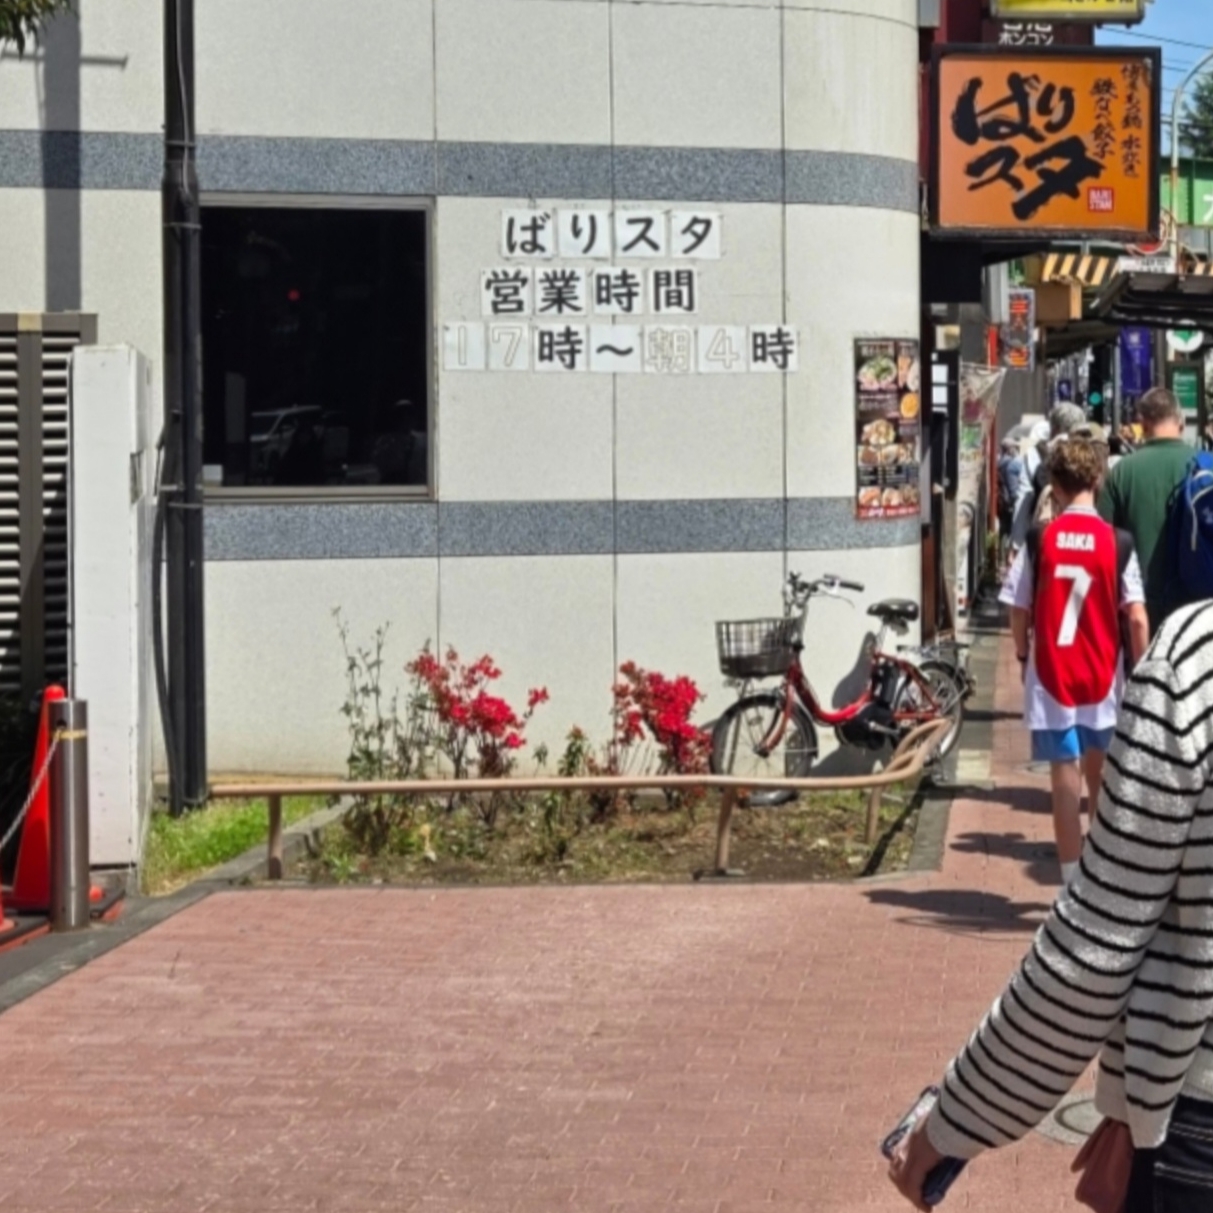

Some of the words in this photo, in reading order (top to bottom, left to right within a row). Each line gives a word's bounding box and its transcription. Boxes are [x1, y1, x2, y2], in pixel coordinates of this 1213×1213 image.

[951, 72, 1075, 146] ばり
[964, 135, 1105, 220] スタ
[505, 211, 713, 254] ばりスタ
[484, 268, 695, 314] 営業時間
[1055, 531, 1095, 551] SAKA
[1054, 563, 1093, 647] 7
